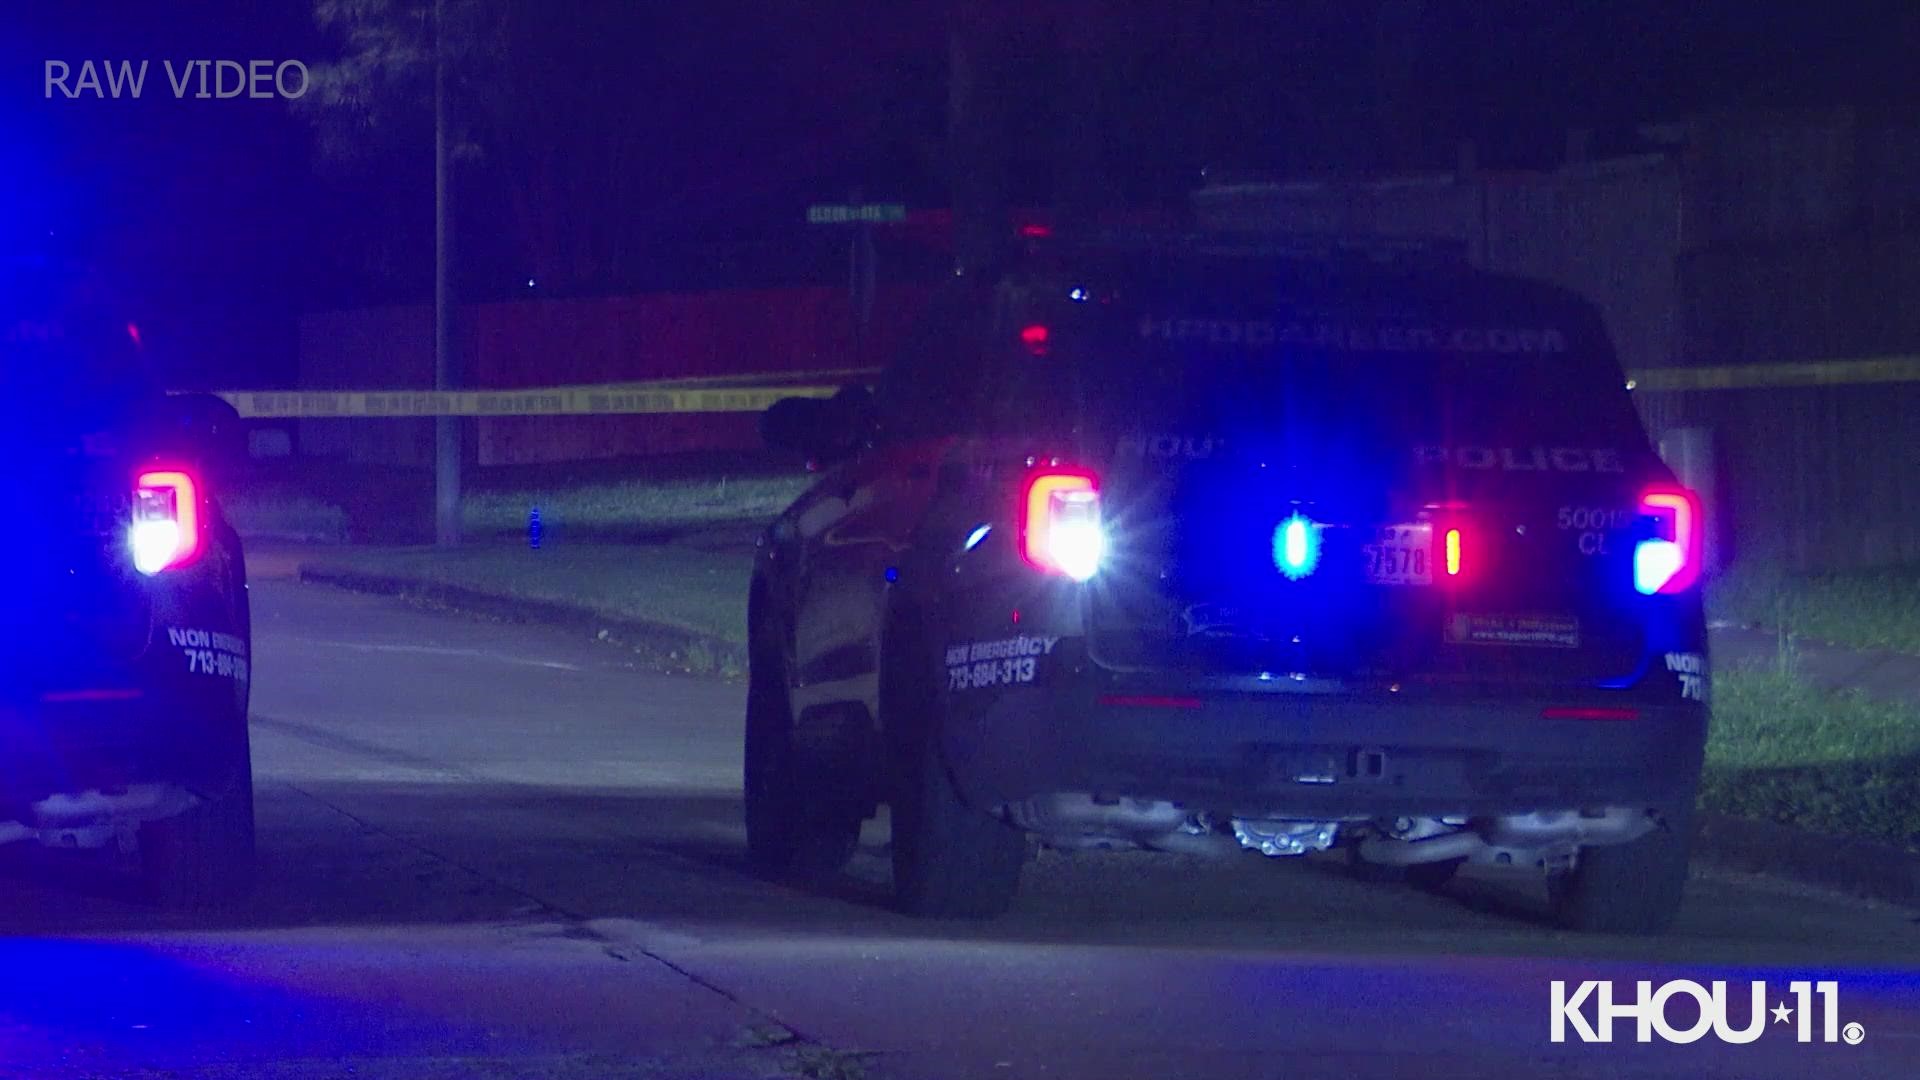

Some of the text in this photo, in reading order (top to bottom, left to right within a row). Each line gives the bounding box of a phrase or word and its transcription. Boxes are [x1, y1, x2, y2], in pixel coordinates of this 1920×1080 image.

[1411, 444, 1626, 474] POLICE
[167, 626, 211, 649] NON
[970, 634, 1059, 663] EMERGENCY
